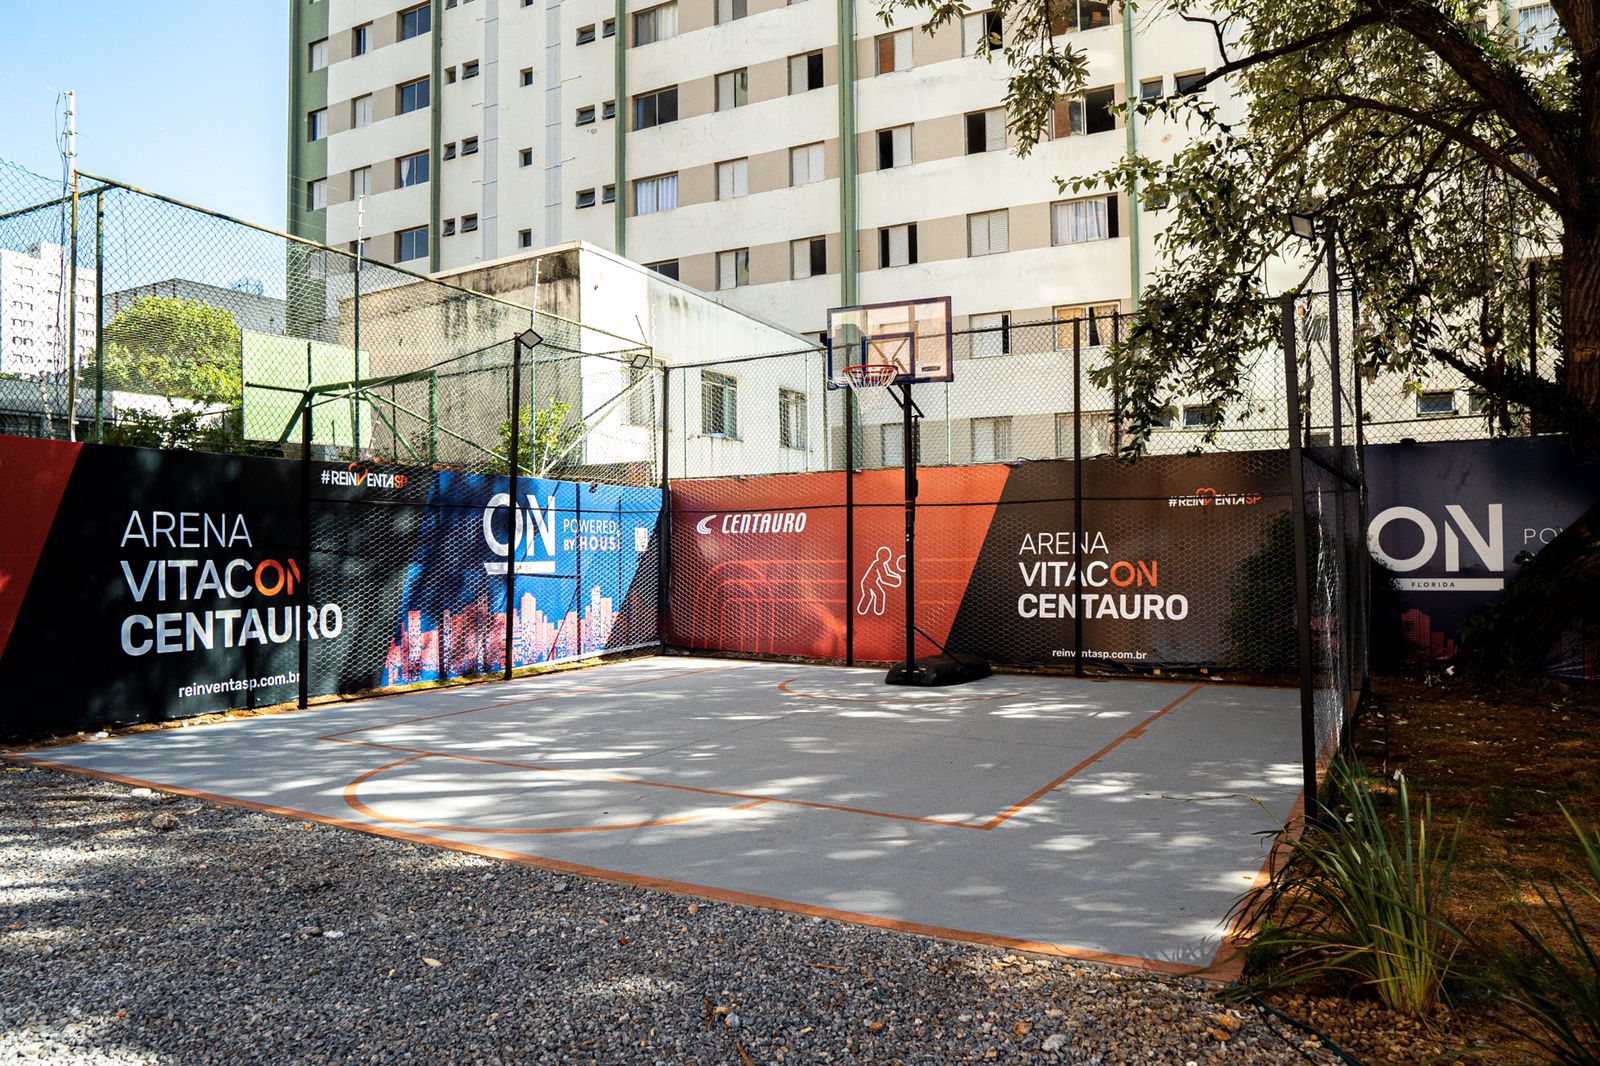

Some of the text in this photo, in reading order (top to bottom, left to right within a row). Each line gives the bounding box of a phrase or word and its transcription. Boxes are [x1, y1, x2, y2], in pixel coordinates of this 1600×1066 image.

[320, 463, 408, 489] #REINVENTASP
[120, 510, 252, 548] ARENA
[483, 493, 556, 557] ON
[563, 518, 616, 534] POWERED
[721, 512, 807, 535] CENTAURO
[563, 538, 575, 551] BY
[1018, 531, 1109, 555] ARENA
[1366, 503, 1504, 572] ON
[1018, 560, 1158, 588] VITACON
[1017, 593, 1189, 620] CENTAURO
[120, 603, 343, 657] CENTAURO
[1052, 648, 1147, 661] reinvntasp.com.br
